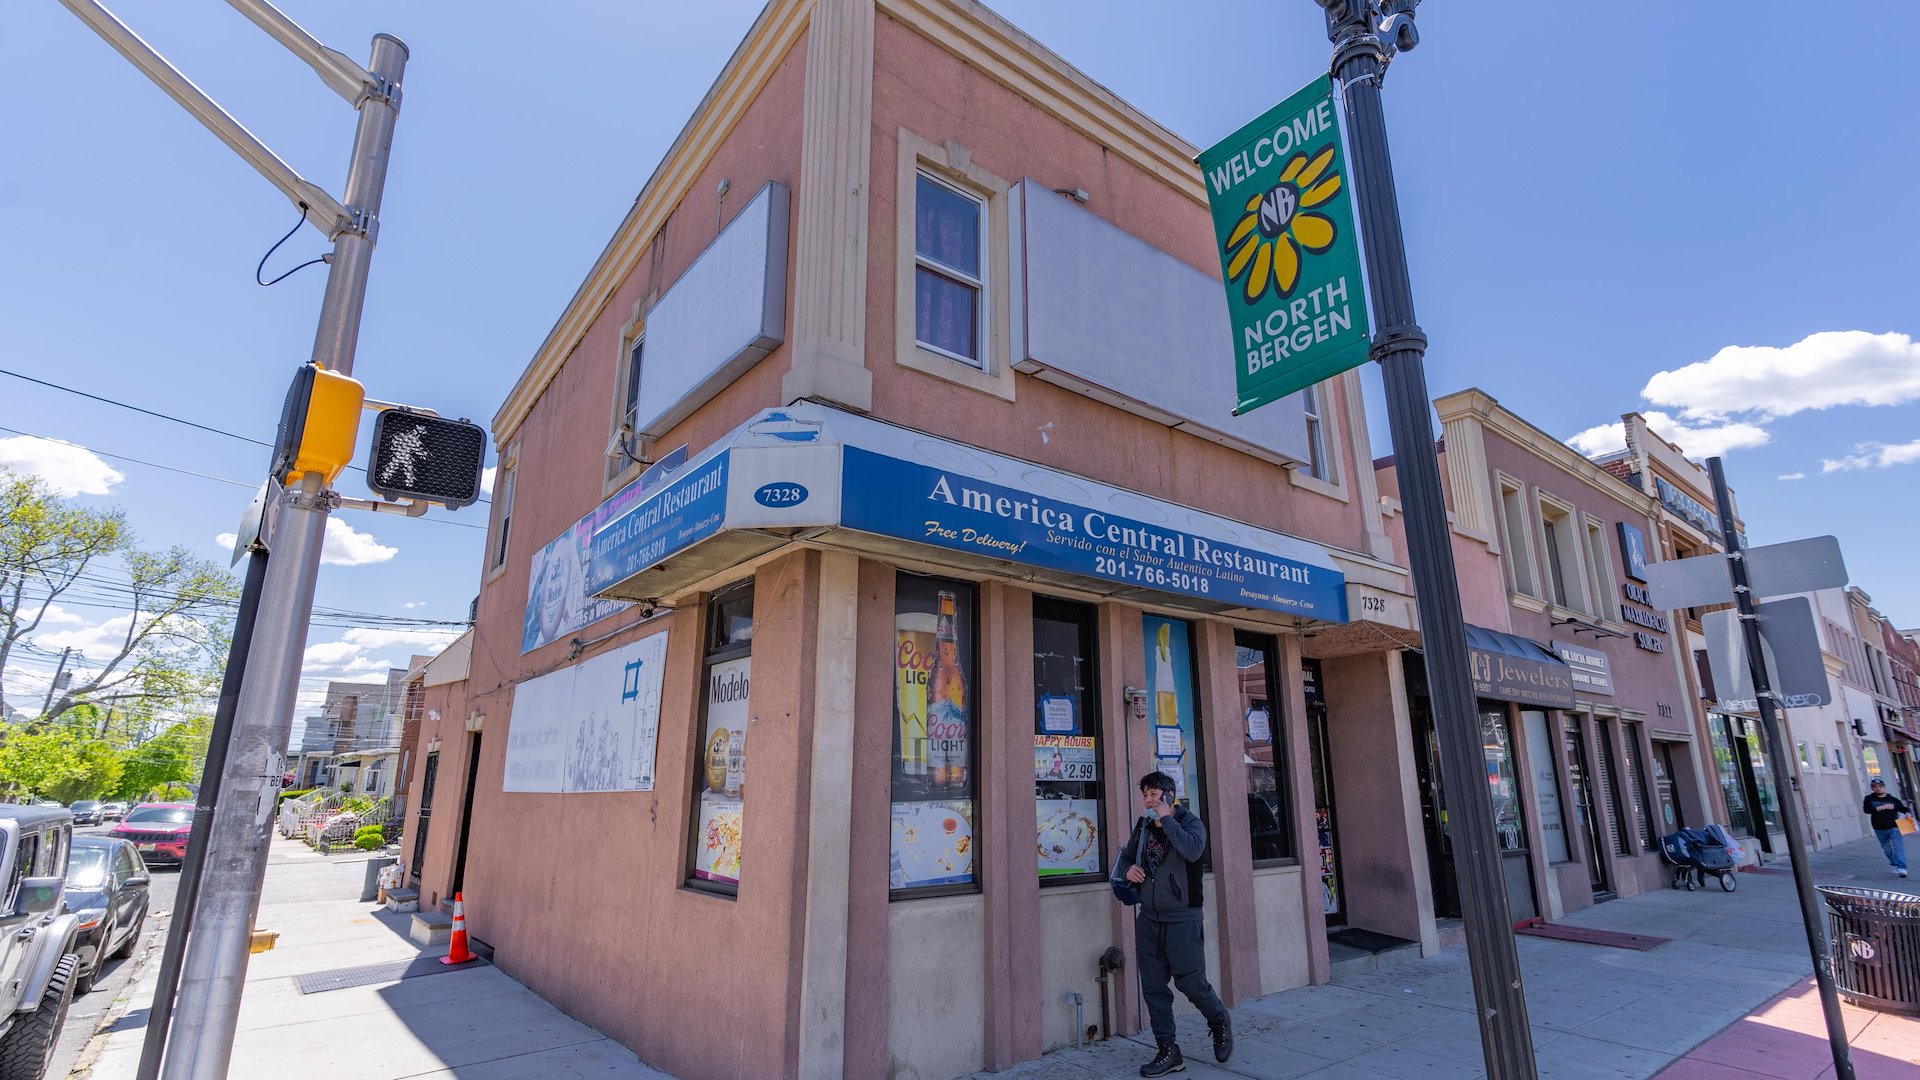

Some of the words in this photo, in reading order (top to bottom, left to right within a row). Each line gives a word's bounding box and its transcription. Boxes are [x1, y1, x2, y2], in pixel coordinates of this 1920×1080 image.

[1209, 99, 1332, 196] WELCOME
[1260, 187, 1296, 232] NB
[1244, 276, 1348, 350] NORTH
[1247, 304, 1351, 376] BERGEN
[594, 525, 626, 559] America
[628, 497, 662, 539] Central
[663, 461, 723, 520] Restaurant
[763, 488, 800, 502] 7328
[924, 520, 958, 540] Free
[961, 528, 1028, 555] Delivery!
[927, 474, 1075, 533] America
[1083, 512, 1185, 558] Central
[1192, 536, 1311, 585] Restaurant
[1046, 529, 1093, 551] Servido
[1096, 543, 1116, 556] con
[1119, 547, 1130, 560] el
[1133, 549, 1165, 566] Sabor
[1167, 557, 1213, 577] Autentico
[1215, 567, 1245, 583] Latino
[1095, 556, 1210, 593] 201-766-5018
[1362, 596, 1385, 613] 7328
[710, 671, 749, 705] Modelo
[1497, 655, 1570, 690] Jewelers
[931, 739, 965, 752] LIGHT
[1034, 735, 1062, 746] HAPPY
[1064, 736, 1092, 747] HOURS
[1064, 763, 1093, 779] $2.99
[1851, 939, 1874, 960] NB
